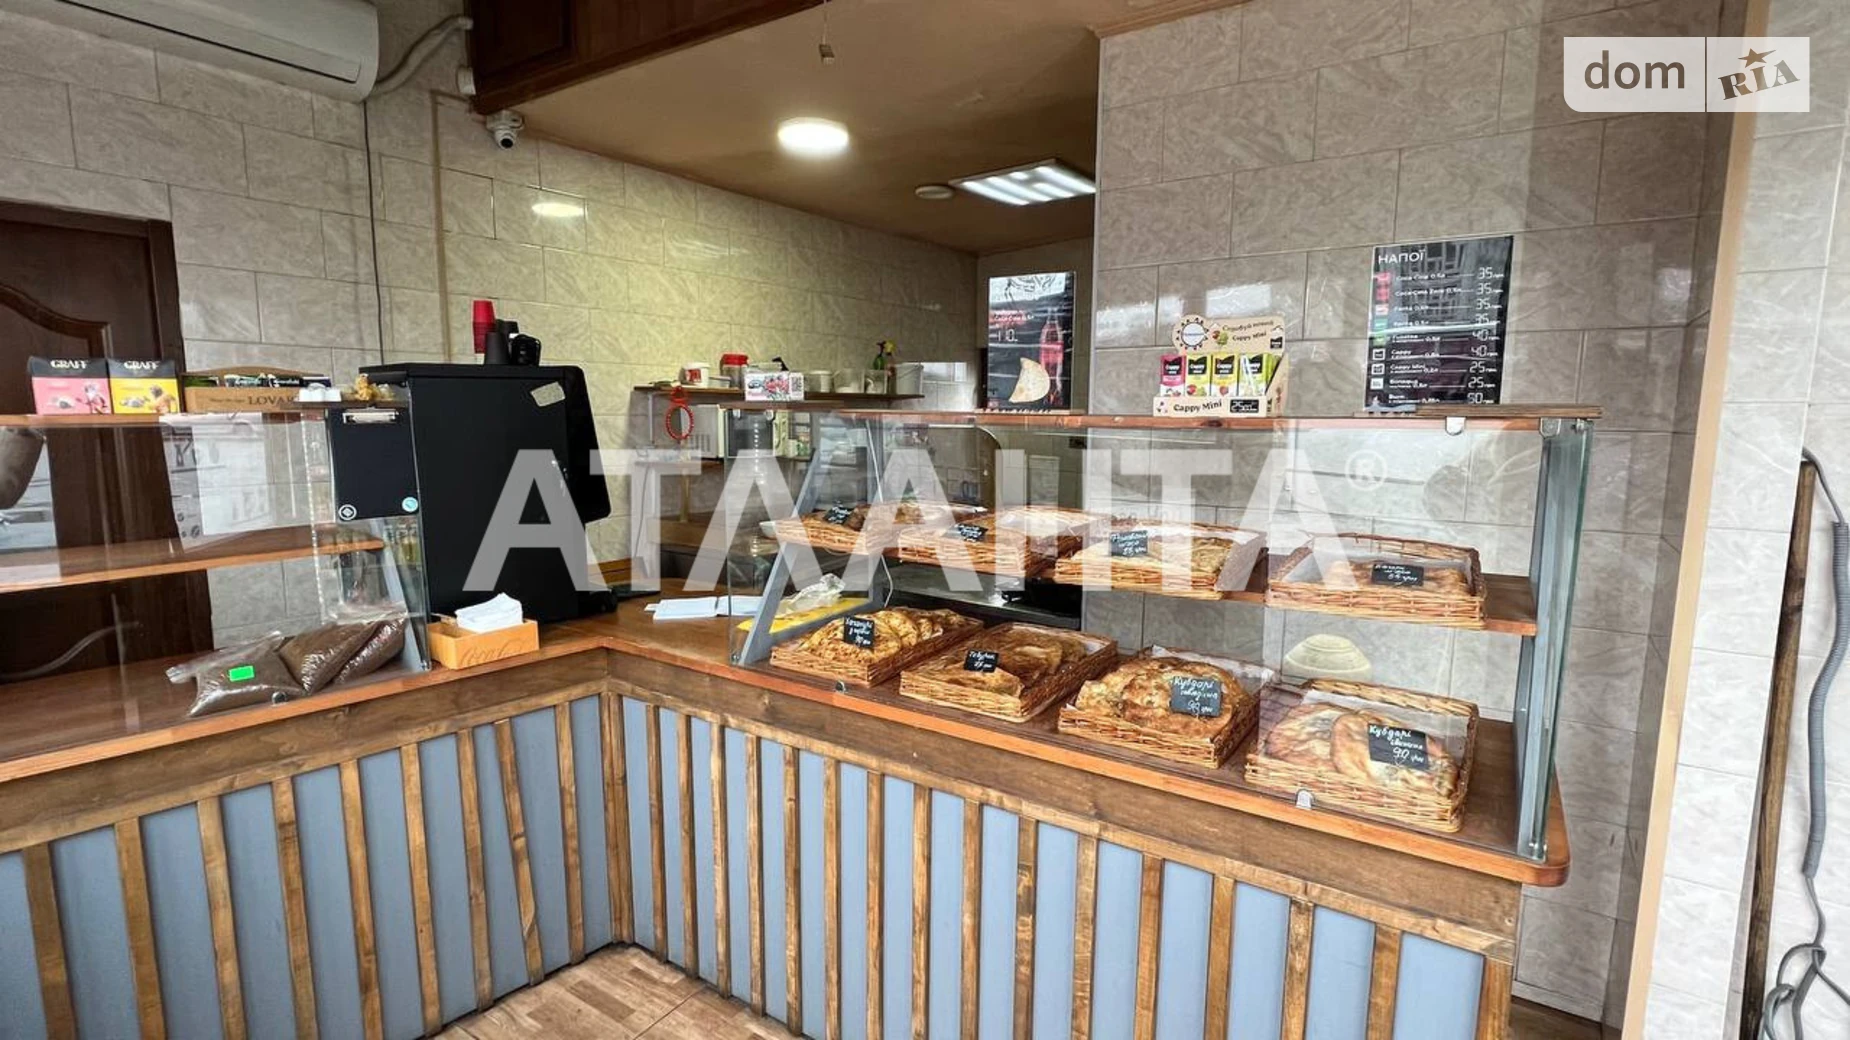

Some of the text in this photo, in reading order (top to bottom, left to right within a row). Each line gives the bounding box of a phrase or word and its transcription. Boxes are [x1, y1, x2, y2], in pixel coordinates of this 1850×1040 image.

[1469, 361, 1486, 374] 25
[1468, 377, 1484, 389] 25
[1173, 399, 1223, 414] Cappy Mini
